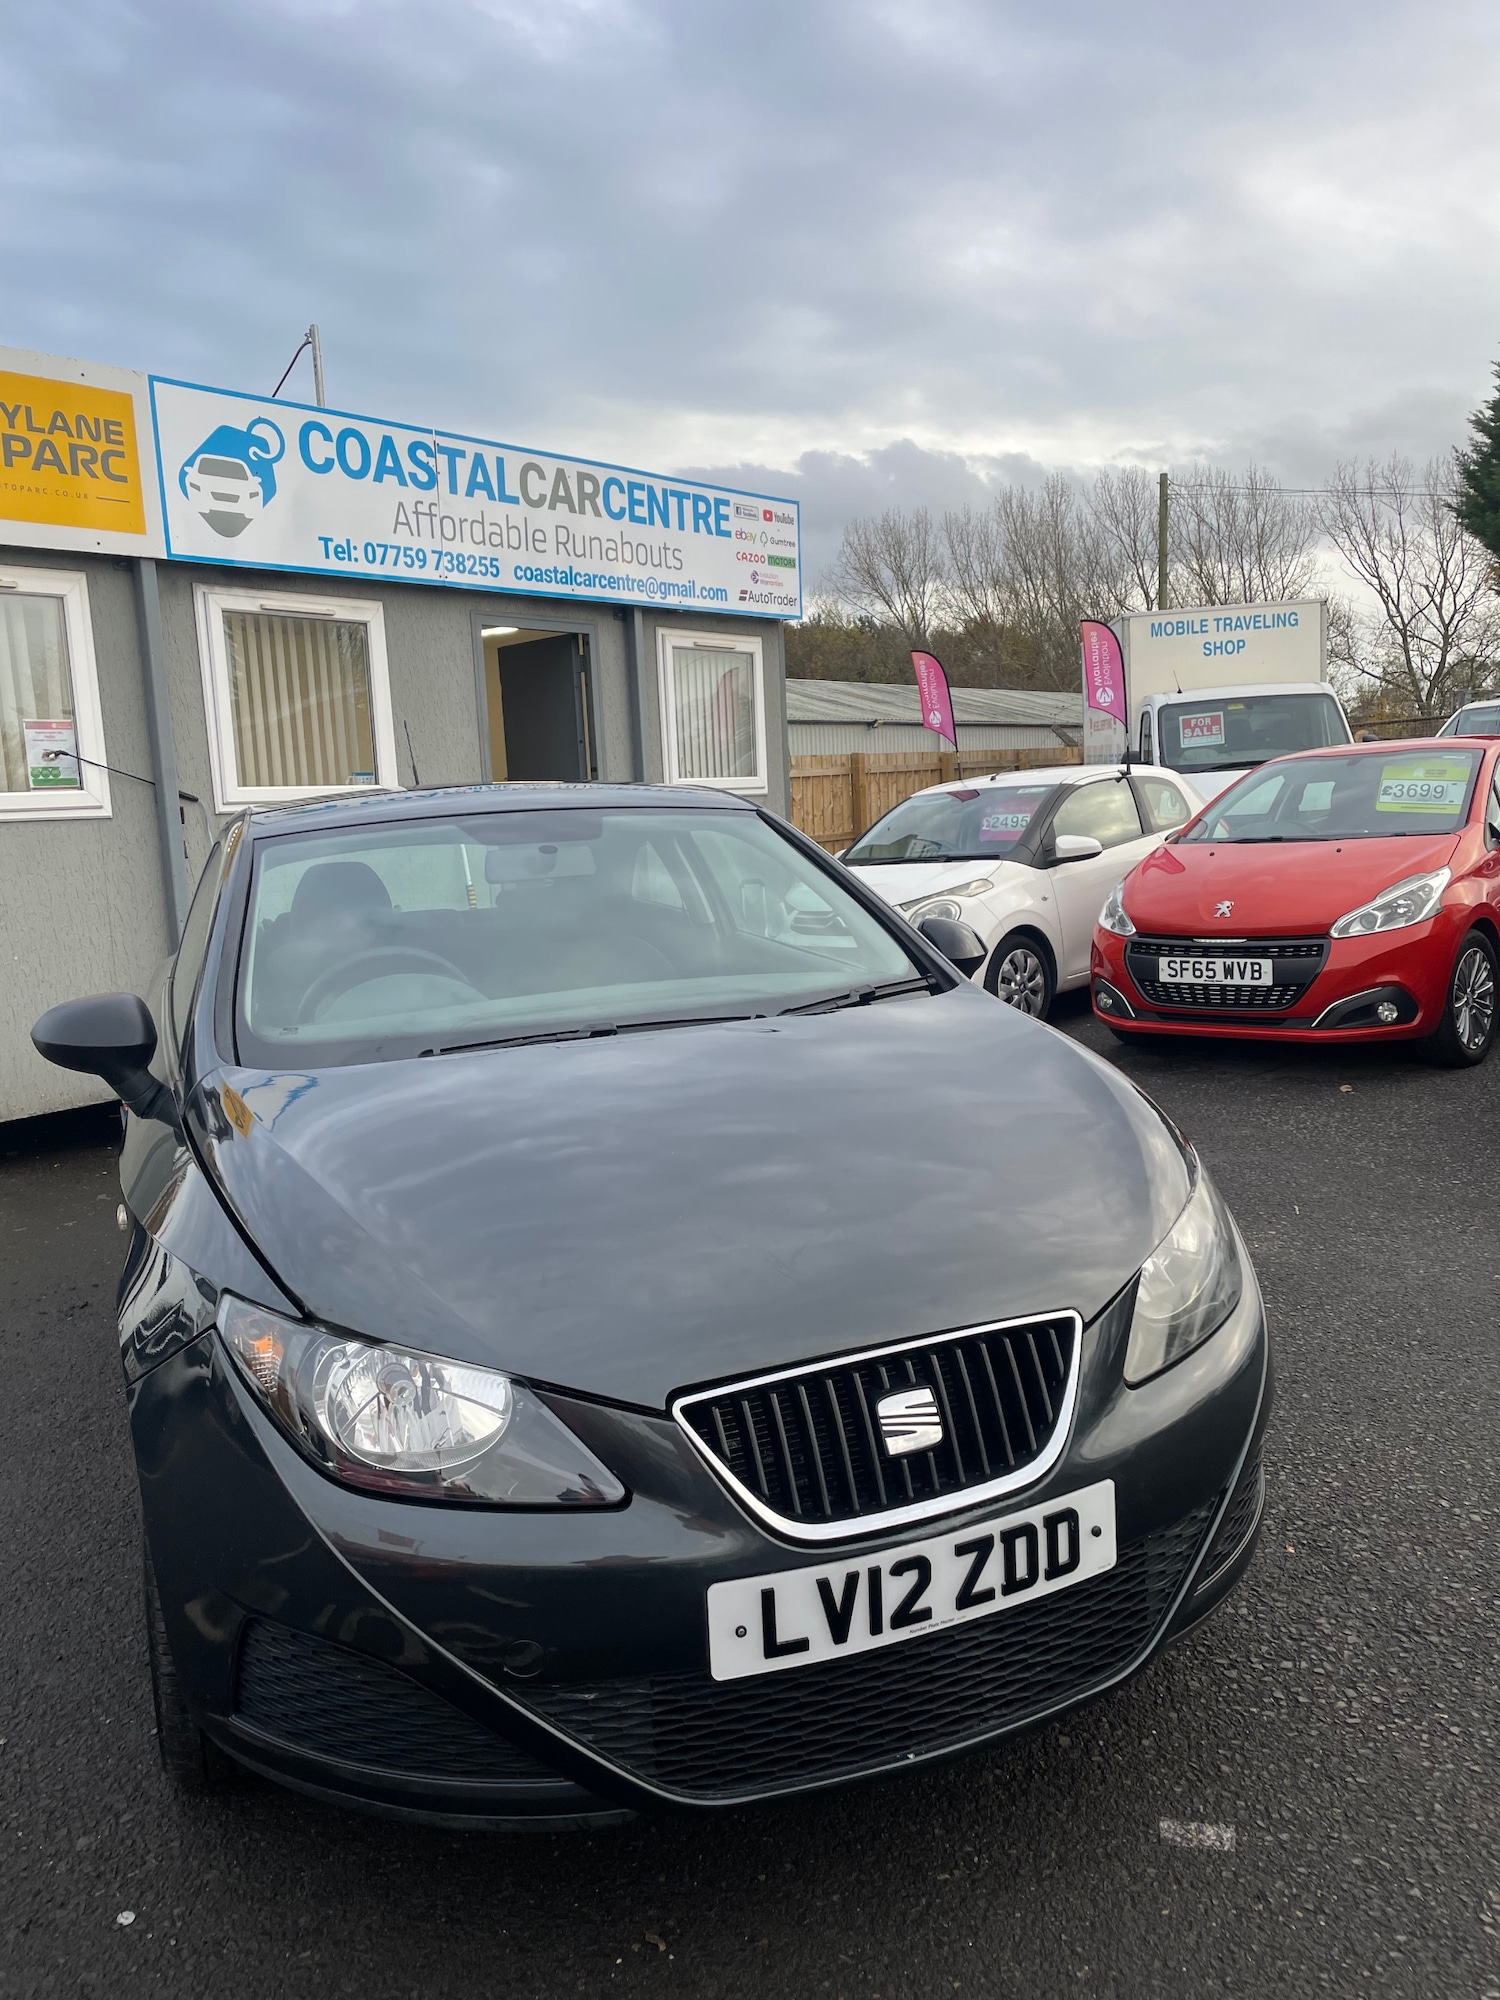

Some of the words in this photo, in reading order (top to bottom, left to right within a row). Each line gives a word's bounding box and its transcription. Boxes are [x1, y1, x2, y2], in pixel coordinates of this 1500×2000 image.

[0, 401, 125, 446] YLANE
[1, 432, 128, 484] PARC
[298, 420, 732, 538] COASTALCARCENTRE
[773, 511, 795, 525] YouTube
[393, 500, 547, 554] Affordable
[555, 524, 683, 571] Runabouts
[735, 528, 757, 544] ebay
[769, 536, 796, 548] Gumtree
[317, 536, 359, 563] Tel:
[363, 541, 427, 569] 07759
[430, 549, 500, 578] 738255
[735, 551, 766, 564] CAZOO
[513, 562, 728, 602] coastalcarcentre@gmail.com
[748, 590, 797, 607] AutoTrader
[1150, 618, 1209, 638] MOBILE
[1213, 611, 1299, 633] TRAVELING
[1202, 639, 1246, 657] SHOP
[1190, 717, 1211, 727] FOR
[1183, 725, 1221, 738] SALE
[1381, 783, 1445, 799] £3699
[981, 815, 1030, 831] £2495
[1167, 960, 1217, 980] SF65
[1222, 960, 1262, 981] WVB
[760, 1554, 933, 1659] LV12
[954, 1506, 1080, 1611] ZDD
